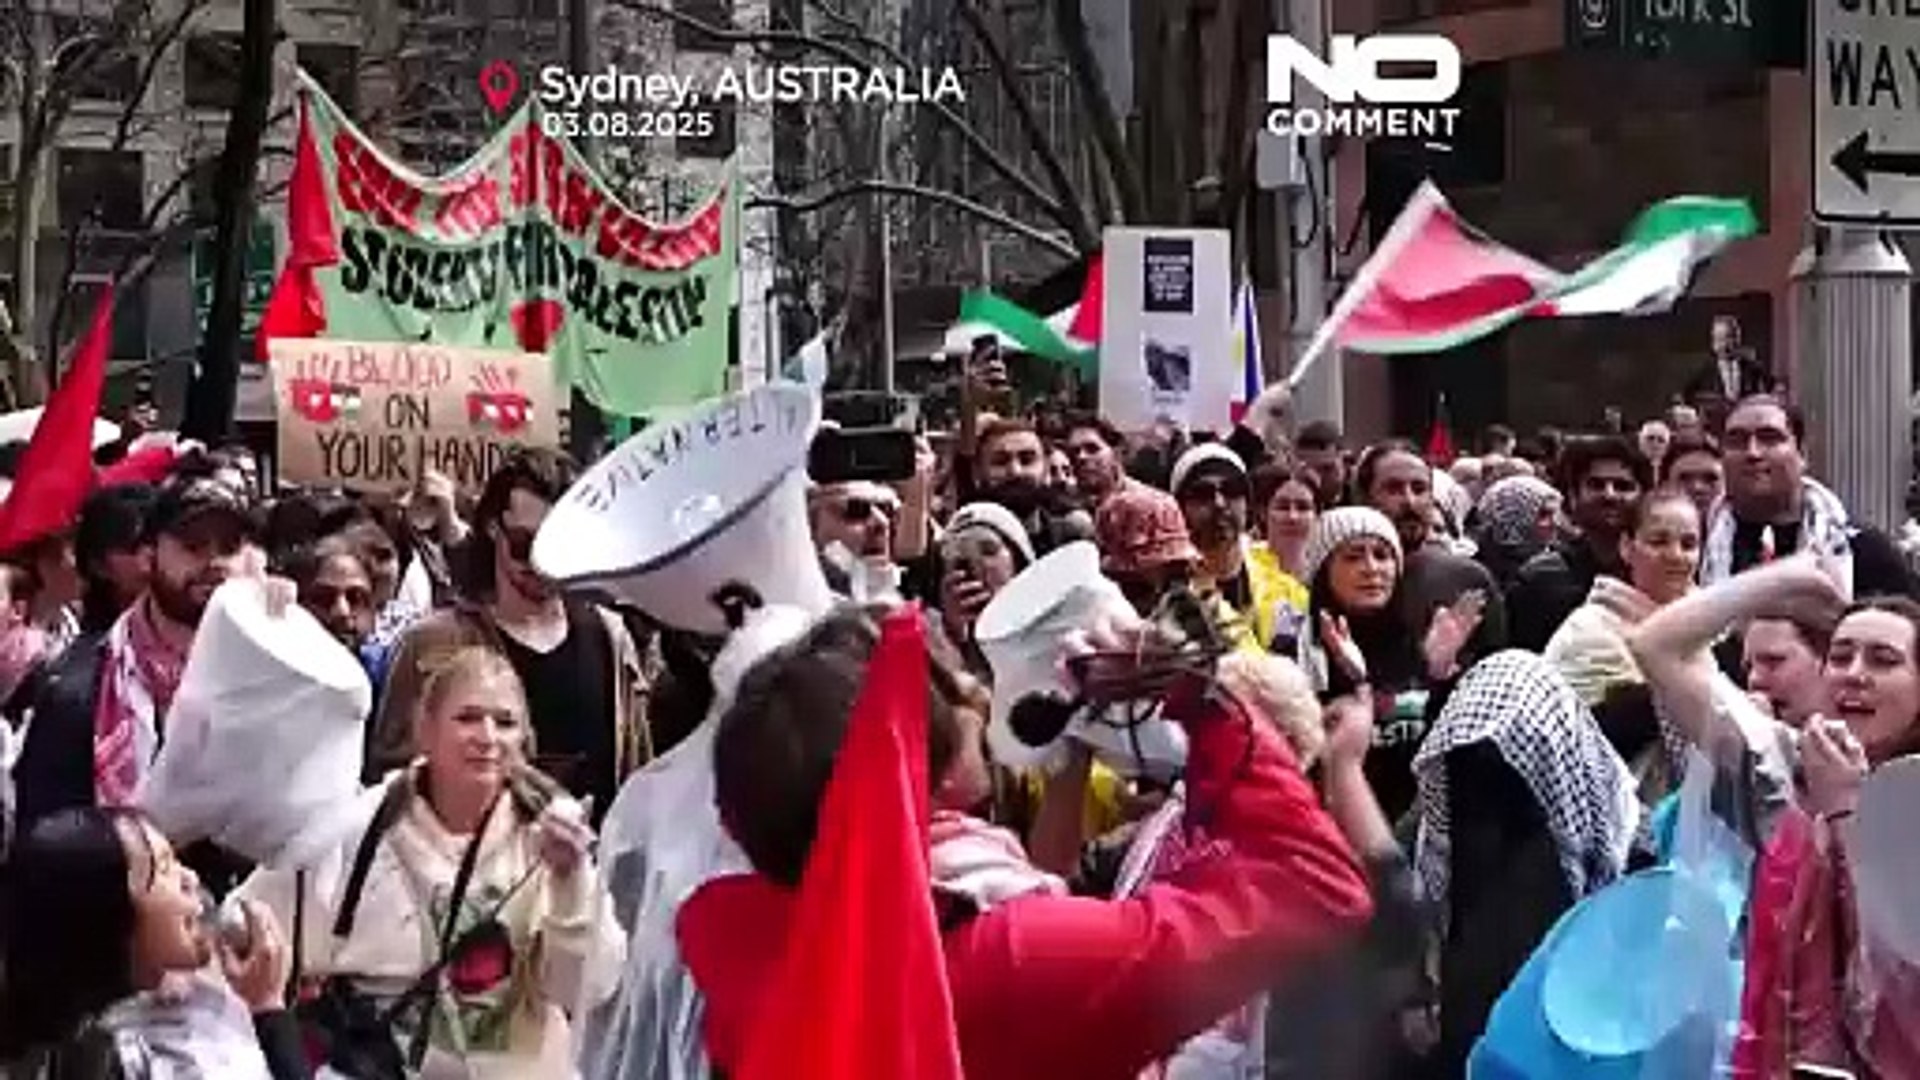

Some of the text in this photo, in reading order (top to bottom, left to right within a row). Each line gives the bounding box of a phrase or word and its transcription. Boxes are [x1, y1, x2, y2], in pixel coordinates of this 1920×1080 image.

[347, 346, 452, 388] BLOOD
[385, 393, 430, 430] ON
[315, 428, 505, 490] YOUR HAND
